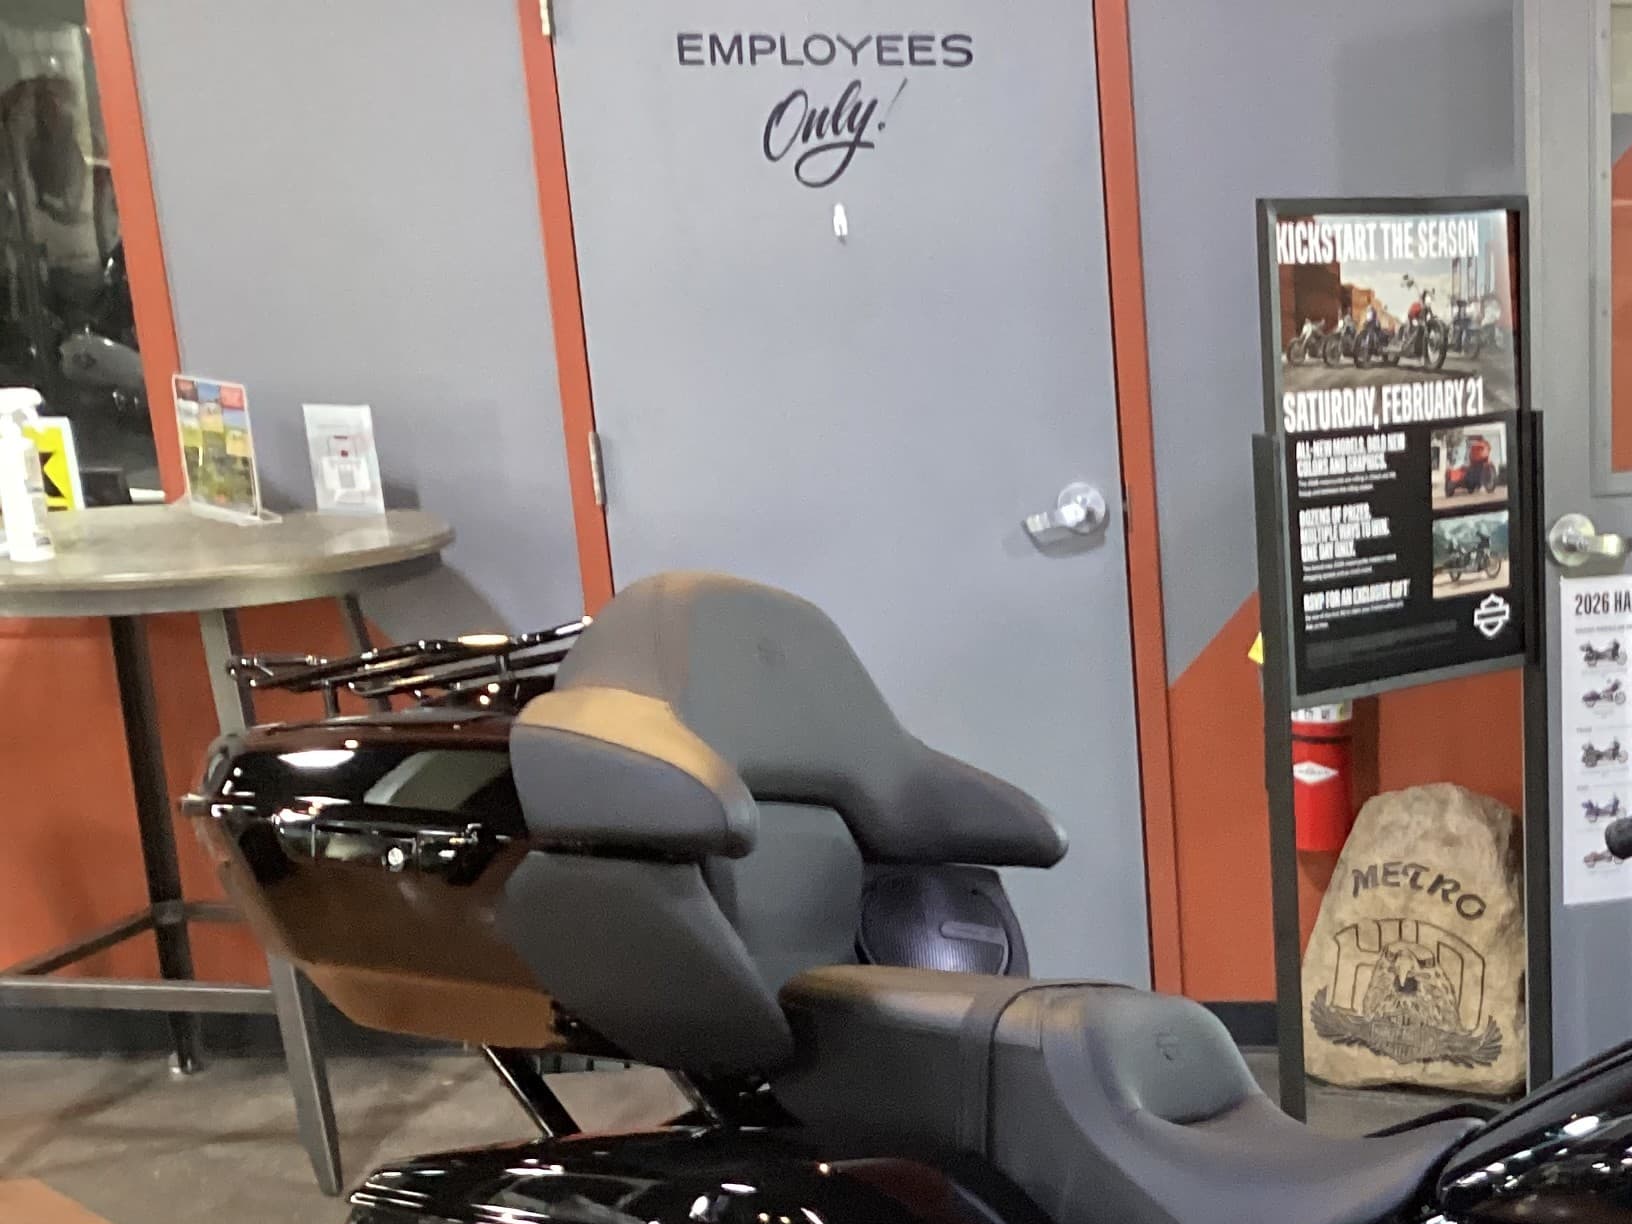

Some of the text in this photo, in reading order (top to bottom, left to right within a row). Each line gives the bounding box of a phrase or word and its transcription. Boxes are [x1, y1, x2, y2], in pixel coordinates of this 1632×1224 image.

[676, 33, 974, 67] EMPLOYEES
[762, 77, 908, 188] Only!
[1275, 218, 1479, 265] KICKSTART THE SEASON
[1283, 375, 1484, 433] SATURDAY, FEBRUARY 21
[1575, 591, 1610, 616] 2026
[1352, 861, 1487, 921] METRO
